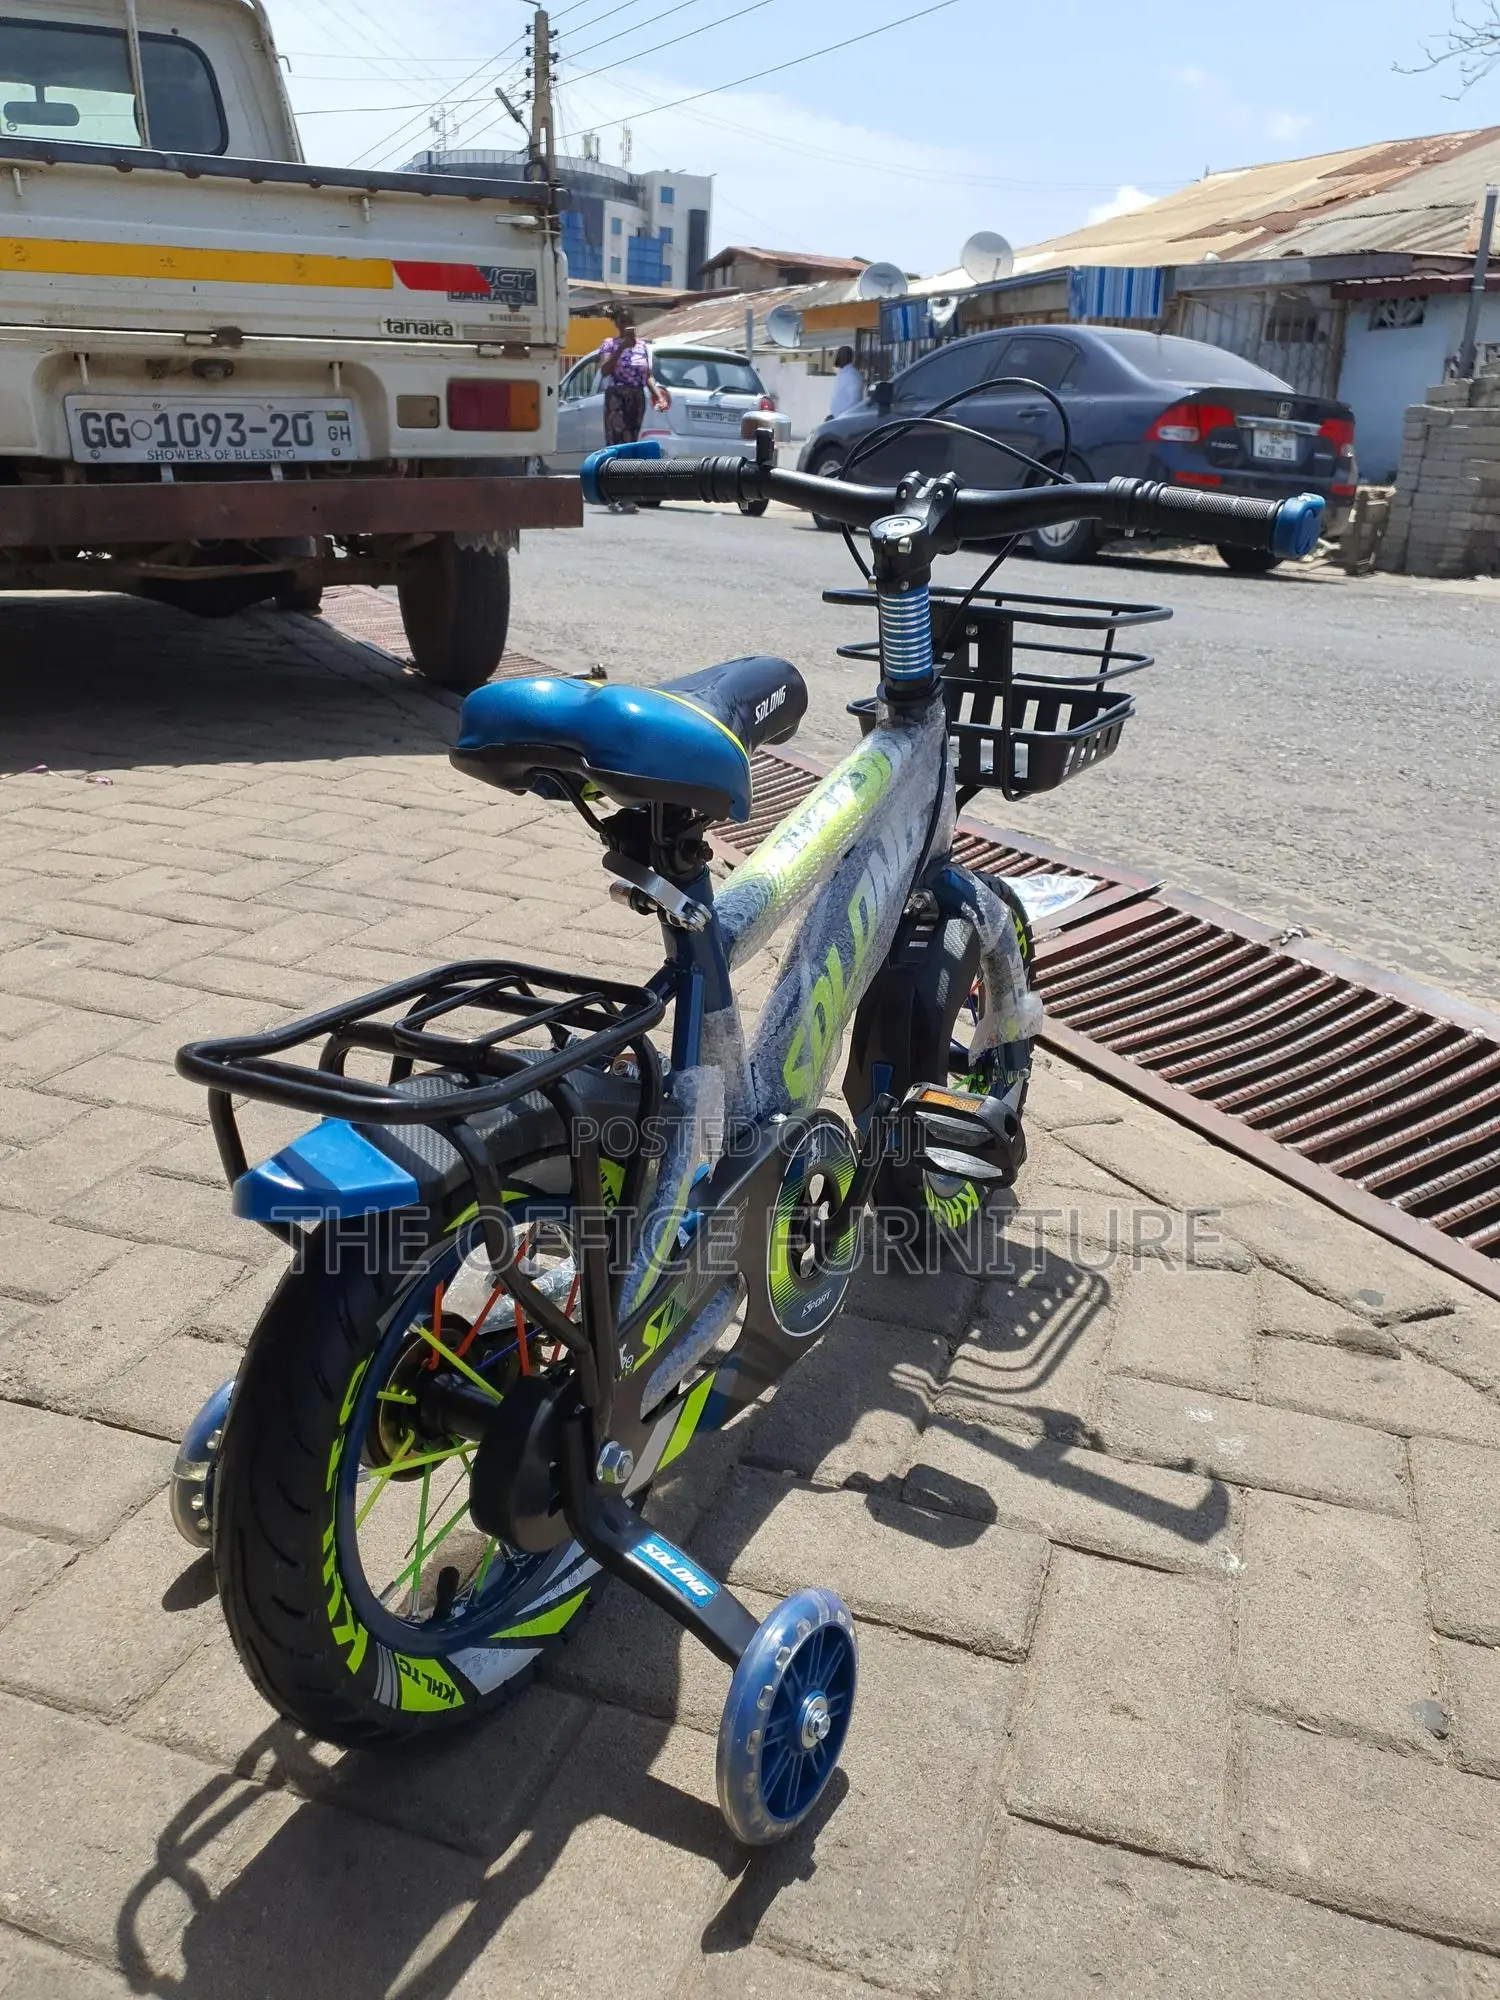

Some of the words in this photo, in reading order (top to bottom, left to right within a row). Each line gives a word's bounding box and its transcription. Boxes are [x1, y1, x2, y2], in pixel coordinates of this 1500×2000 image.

[79, 412, 131, 449] GG
[154, 412, 314, 449] 1093-20
[327, 425, 351, 442] GH
[146, 449, 211, 461] SHOWERS
[214, 449, 231, 460] OF
[235, 449, 296, 461] BLESSING
[754, 684, 787, 725] SOLONG
[637, 1543, 714, 1596] SOLONG
